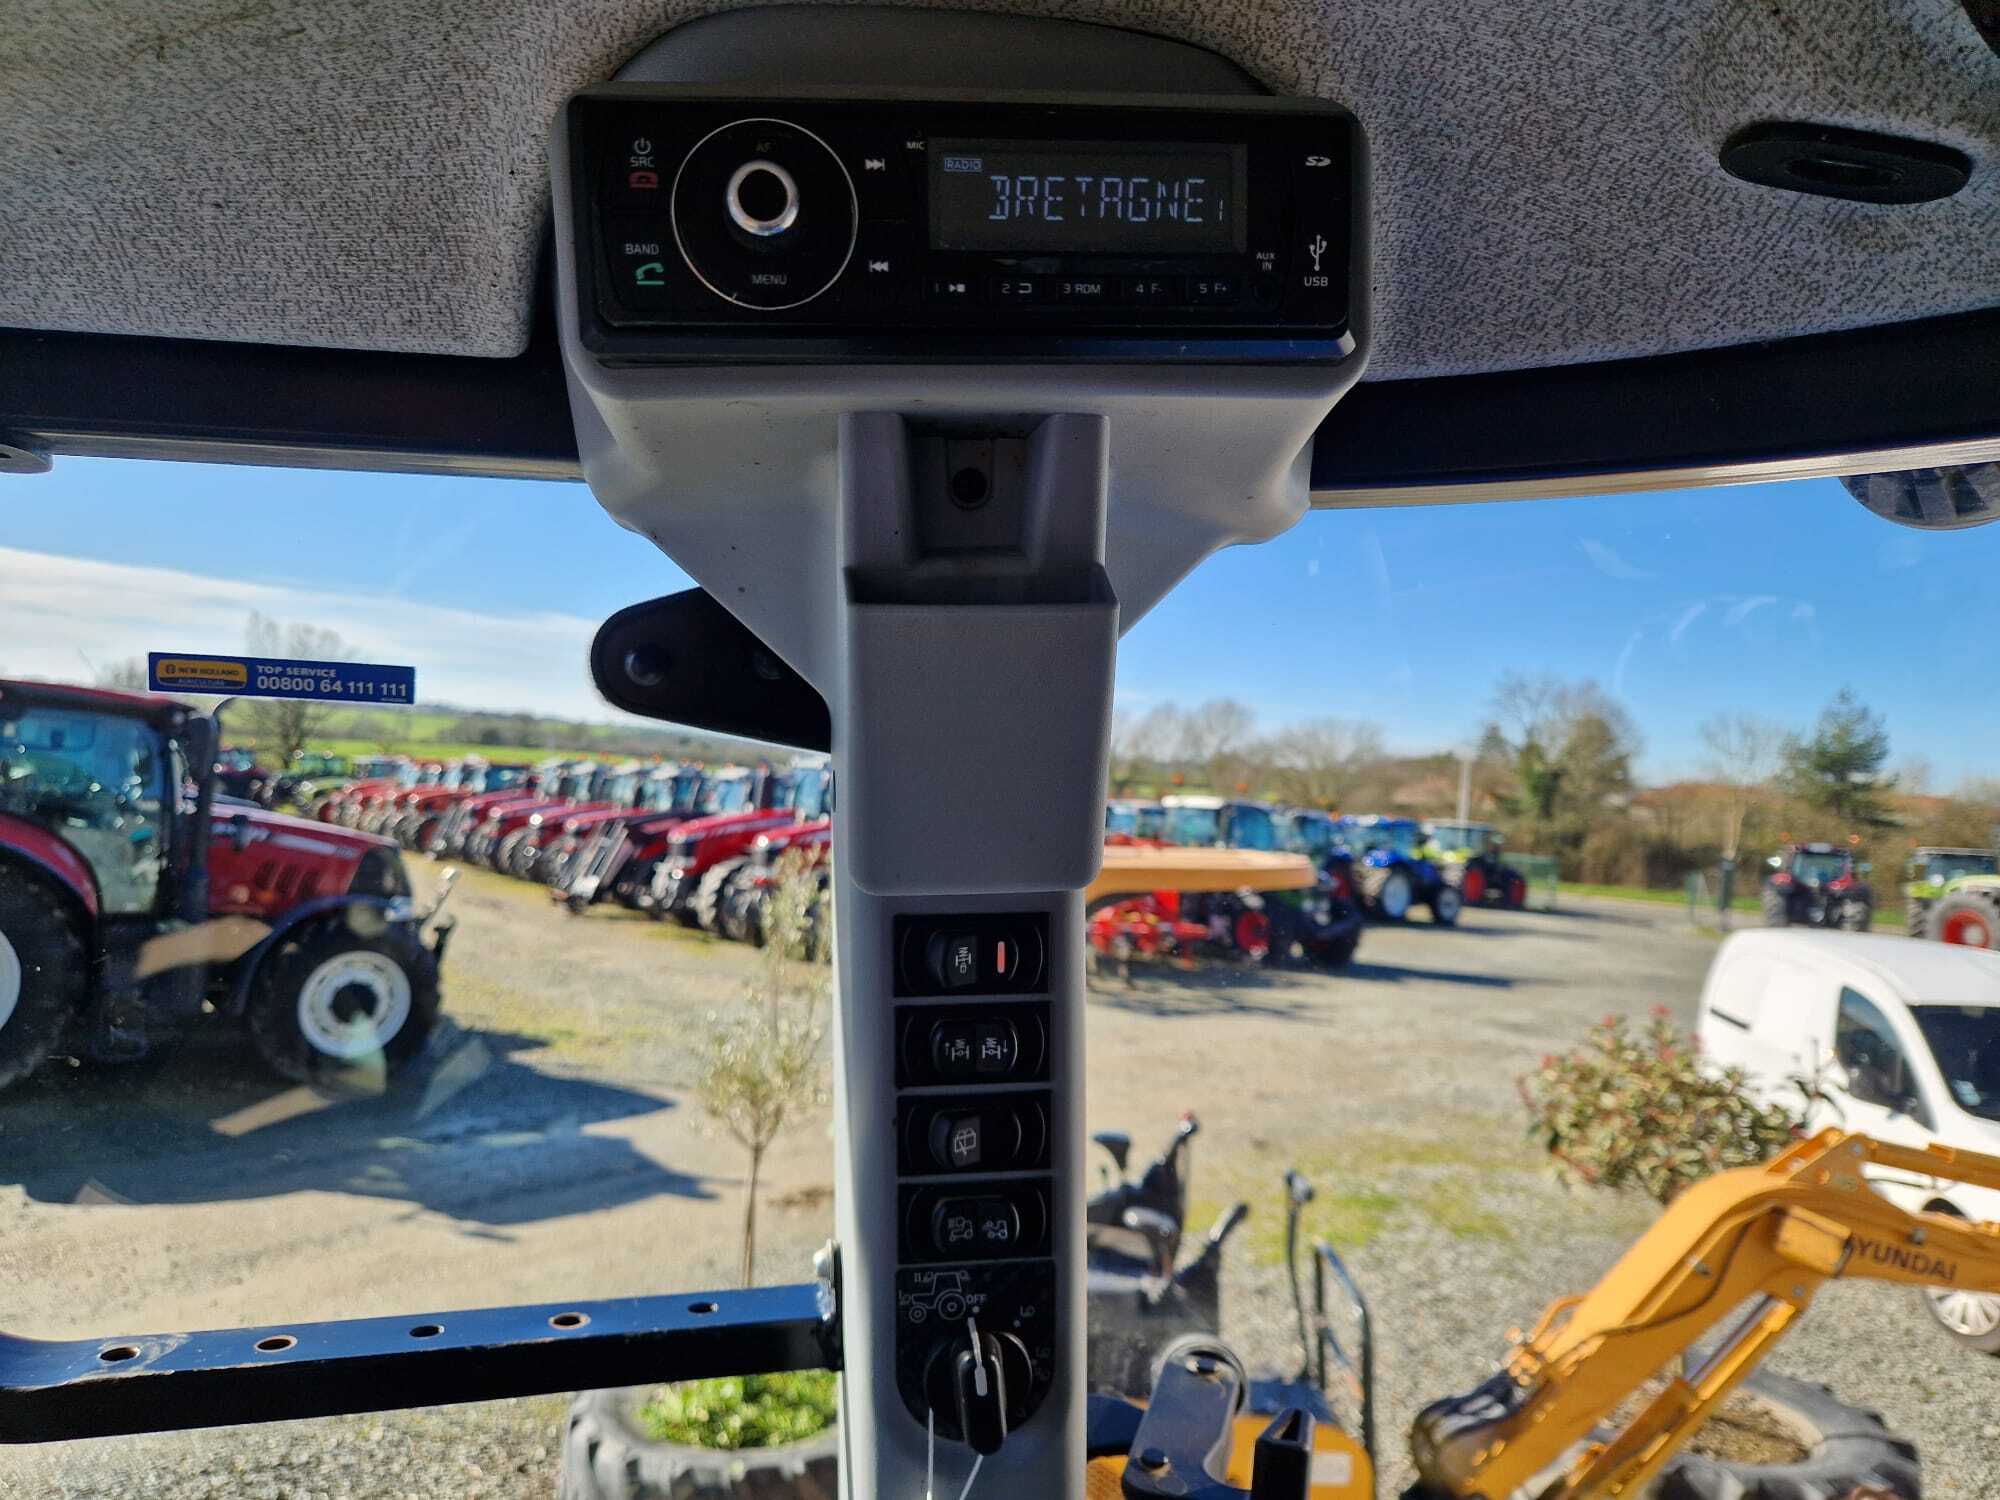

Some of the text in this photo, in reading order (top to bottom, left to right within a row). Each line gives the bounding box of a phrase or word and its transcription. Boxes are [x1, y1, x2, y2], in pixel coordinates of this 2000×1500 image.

[906, 141, 925, 150] MIC
[630, 156, 655, 168] SRC
[945, 160, 981, 171] RADIO
[625, 243, 660, 255] BAND
[1256, 251, 1276, 260] AUX
[1261, 262, 1272, 271] IN
[752, 274, 788, 286] MENU
[1303, 275, 1329, 287] USB
[1001, 283, 1010, 294] 2
[1063, 283, 1101, 294] 3 RDM
[1136, 283, 1145, 294] 4
[1199, 283, 1207, 294] 5
[256, 664, 337, 678] TOP SERVICE
[257, 675, 407, 698] 00800 64 111 111
[966, 1294, 987, 1304] OFF
